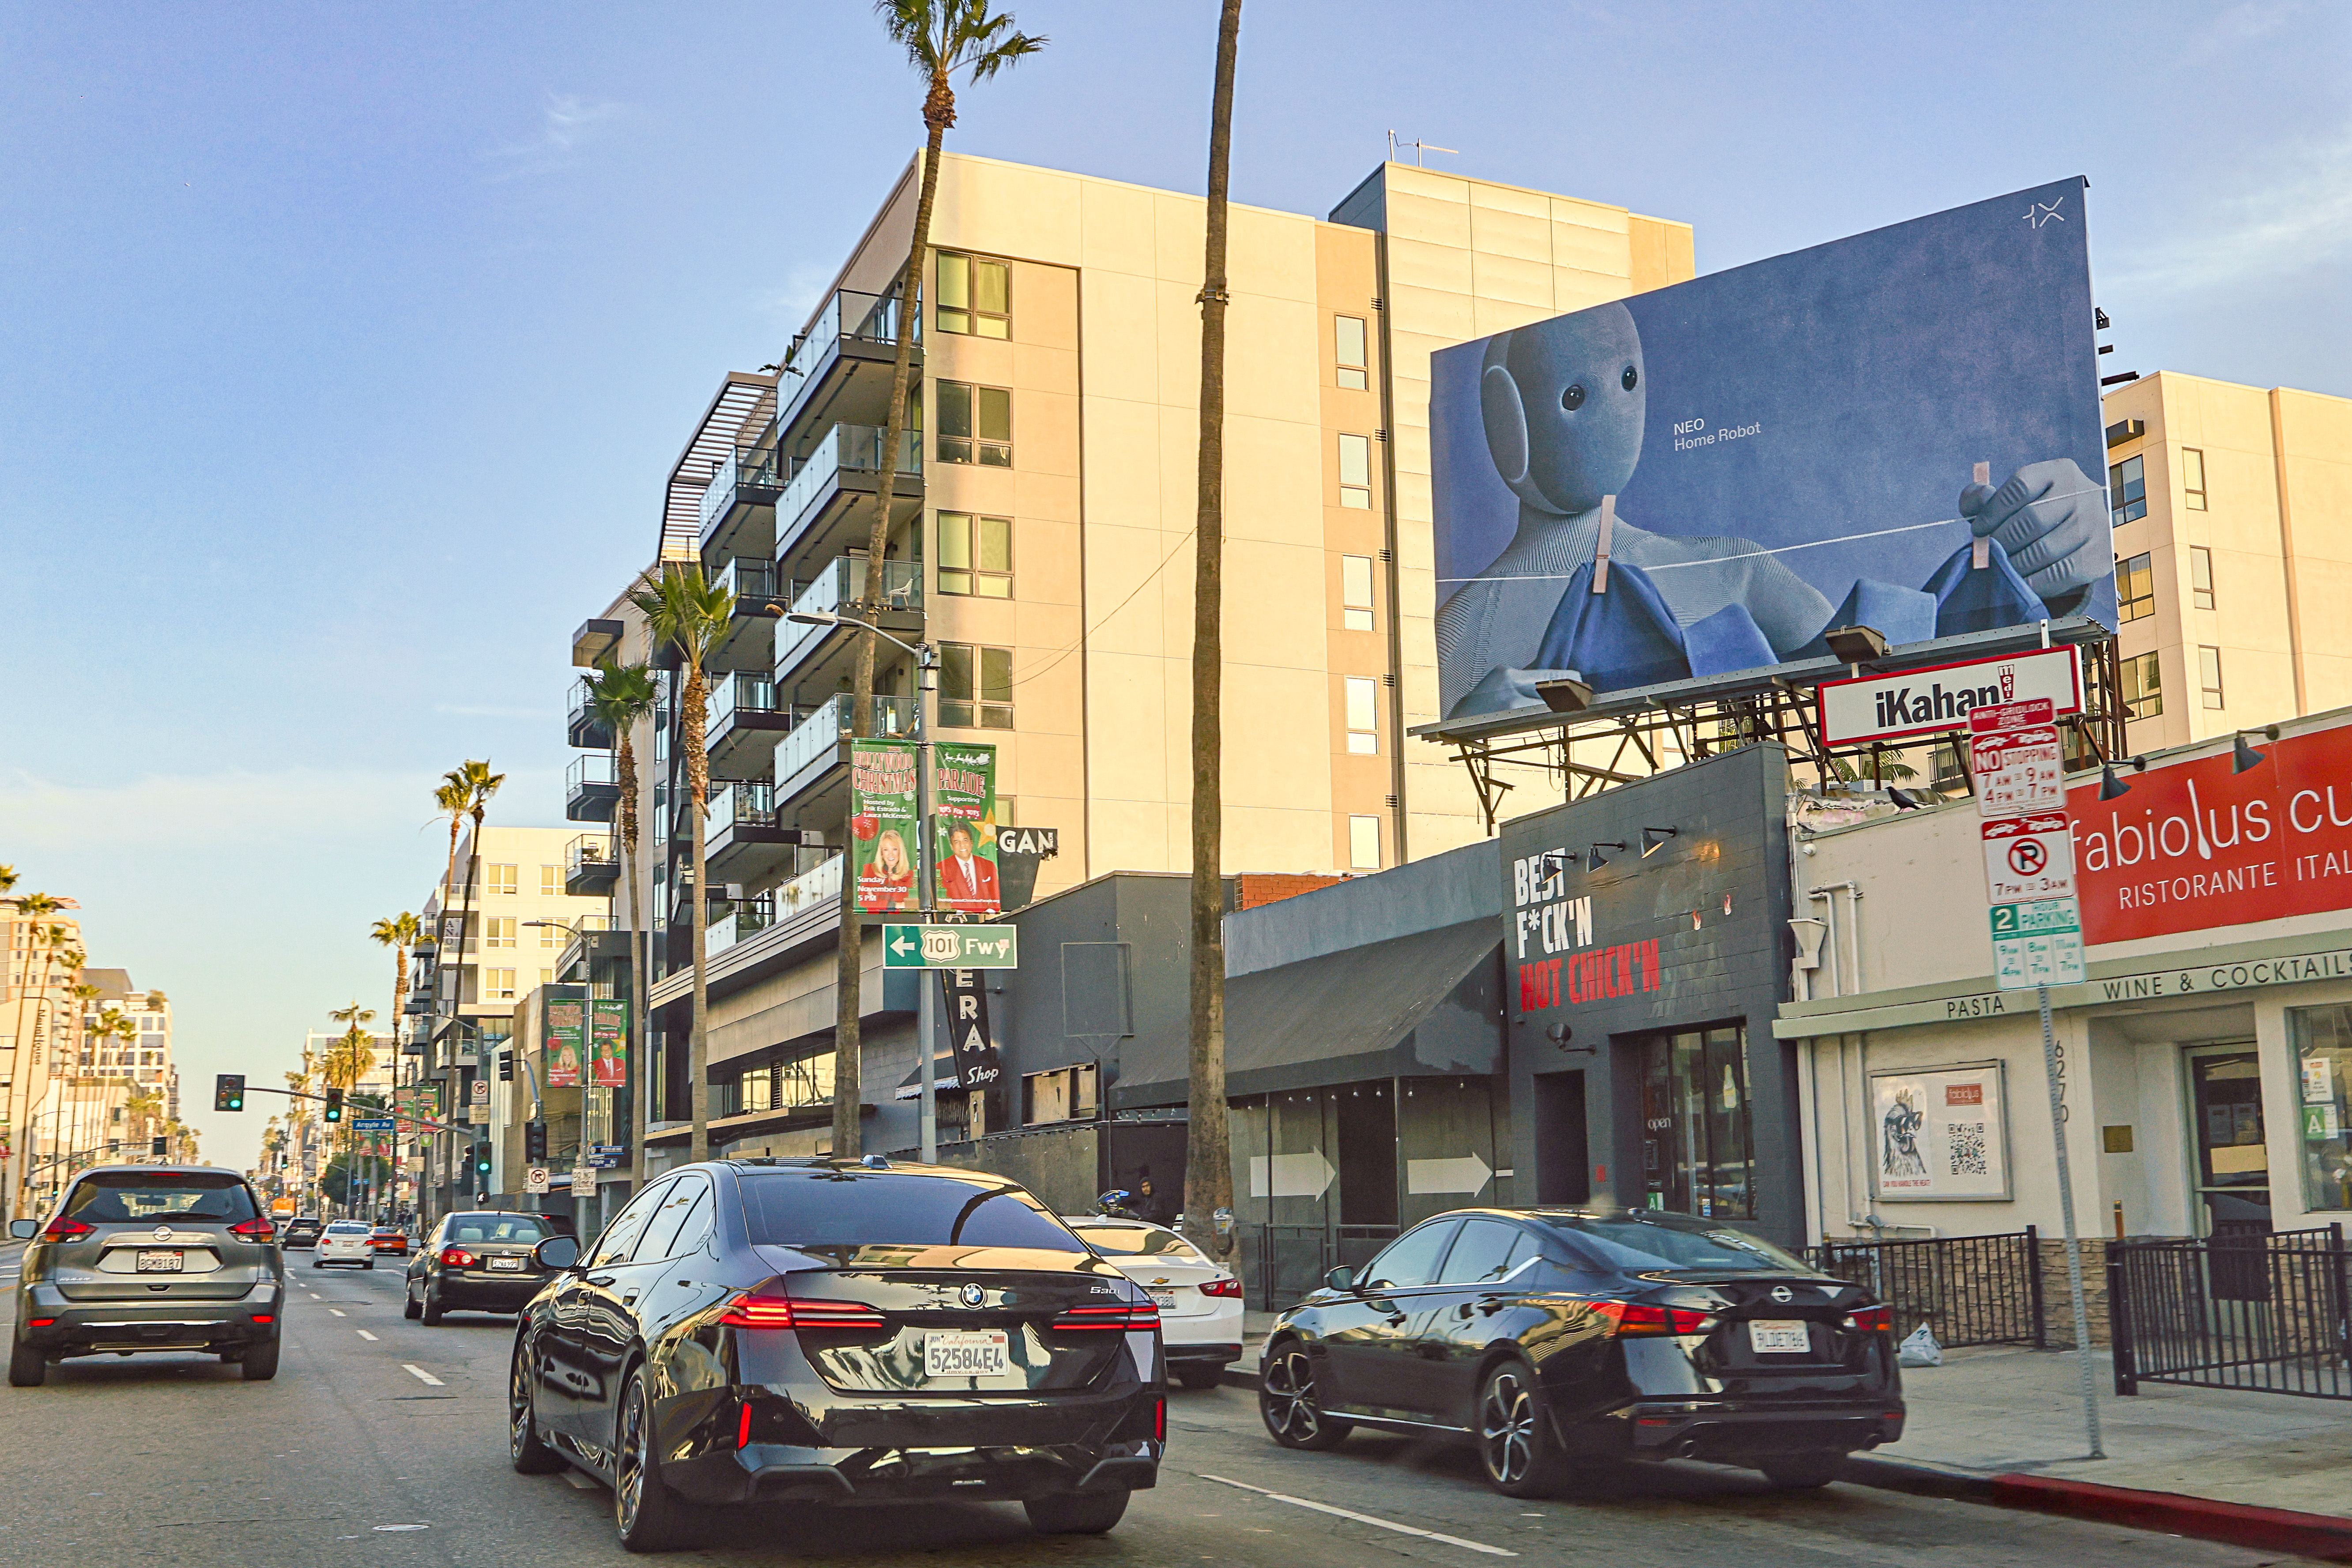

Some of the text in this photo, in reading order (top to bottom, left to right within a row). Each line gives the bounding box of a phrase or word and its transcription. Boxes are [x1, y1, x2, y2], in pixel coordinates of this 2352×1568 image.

[1674, 418, 1704, 435] NEO
[1675, 422, 1761, 451] Home Robot
[1998, 664, 2015, 701] medi
[1875, 683, 2000, 728] iKahan
[1972, 702, 2050, 720] ANTI-GRIDLOCK
[1997, 714, 2027, 726] ZONE
[852, 751, 914, 773] HOLLYWOOD
[1975, 746, 2057, 771] NO STOPPING
[852, 767, 916, 795] CHRISTMAS
[937, 767, 986, 798] PARADE
[1982, 773, 1991, 788] 7
[2025, 767, 2036, 782] 9
[946, 795, 980, 804] Supporting
[1985, 788, 1994, 803] 4
[2027, 783, 2037, 798] 7
[999, 829, 1055, 854] GAN
[857, 876, 886, 885] Sunday
[1514, 847, 1566, 907] BEST
[2119, 861, 2277, 910] RISTORANTE
[1995, 908, 2014, 930] 2
[2021, 909, 2075, 928] PARKING
[928, 938, 952, 953] 101
[965, 938, 1009, 959] Fwy
[1519, 939, 1660, 1012] HOT CHICK'N
[2102, 976, 2163, 1001] WINE
[2179, 972, 2194, 992] &
[1947, 995, 2005, 1019] PASTA
[966, 1065, 999, 1085] Shop
[1648, 1117, 1671, 1132] open
[2307, 1115, 2322, 1133] A
[1649, 1197, 1656, 1210] A
[942, 1335, 993, 1348] California
[931, 1348, 1003, 1369] 52584E4
